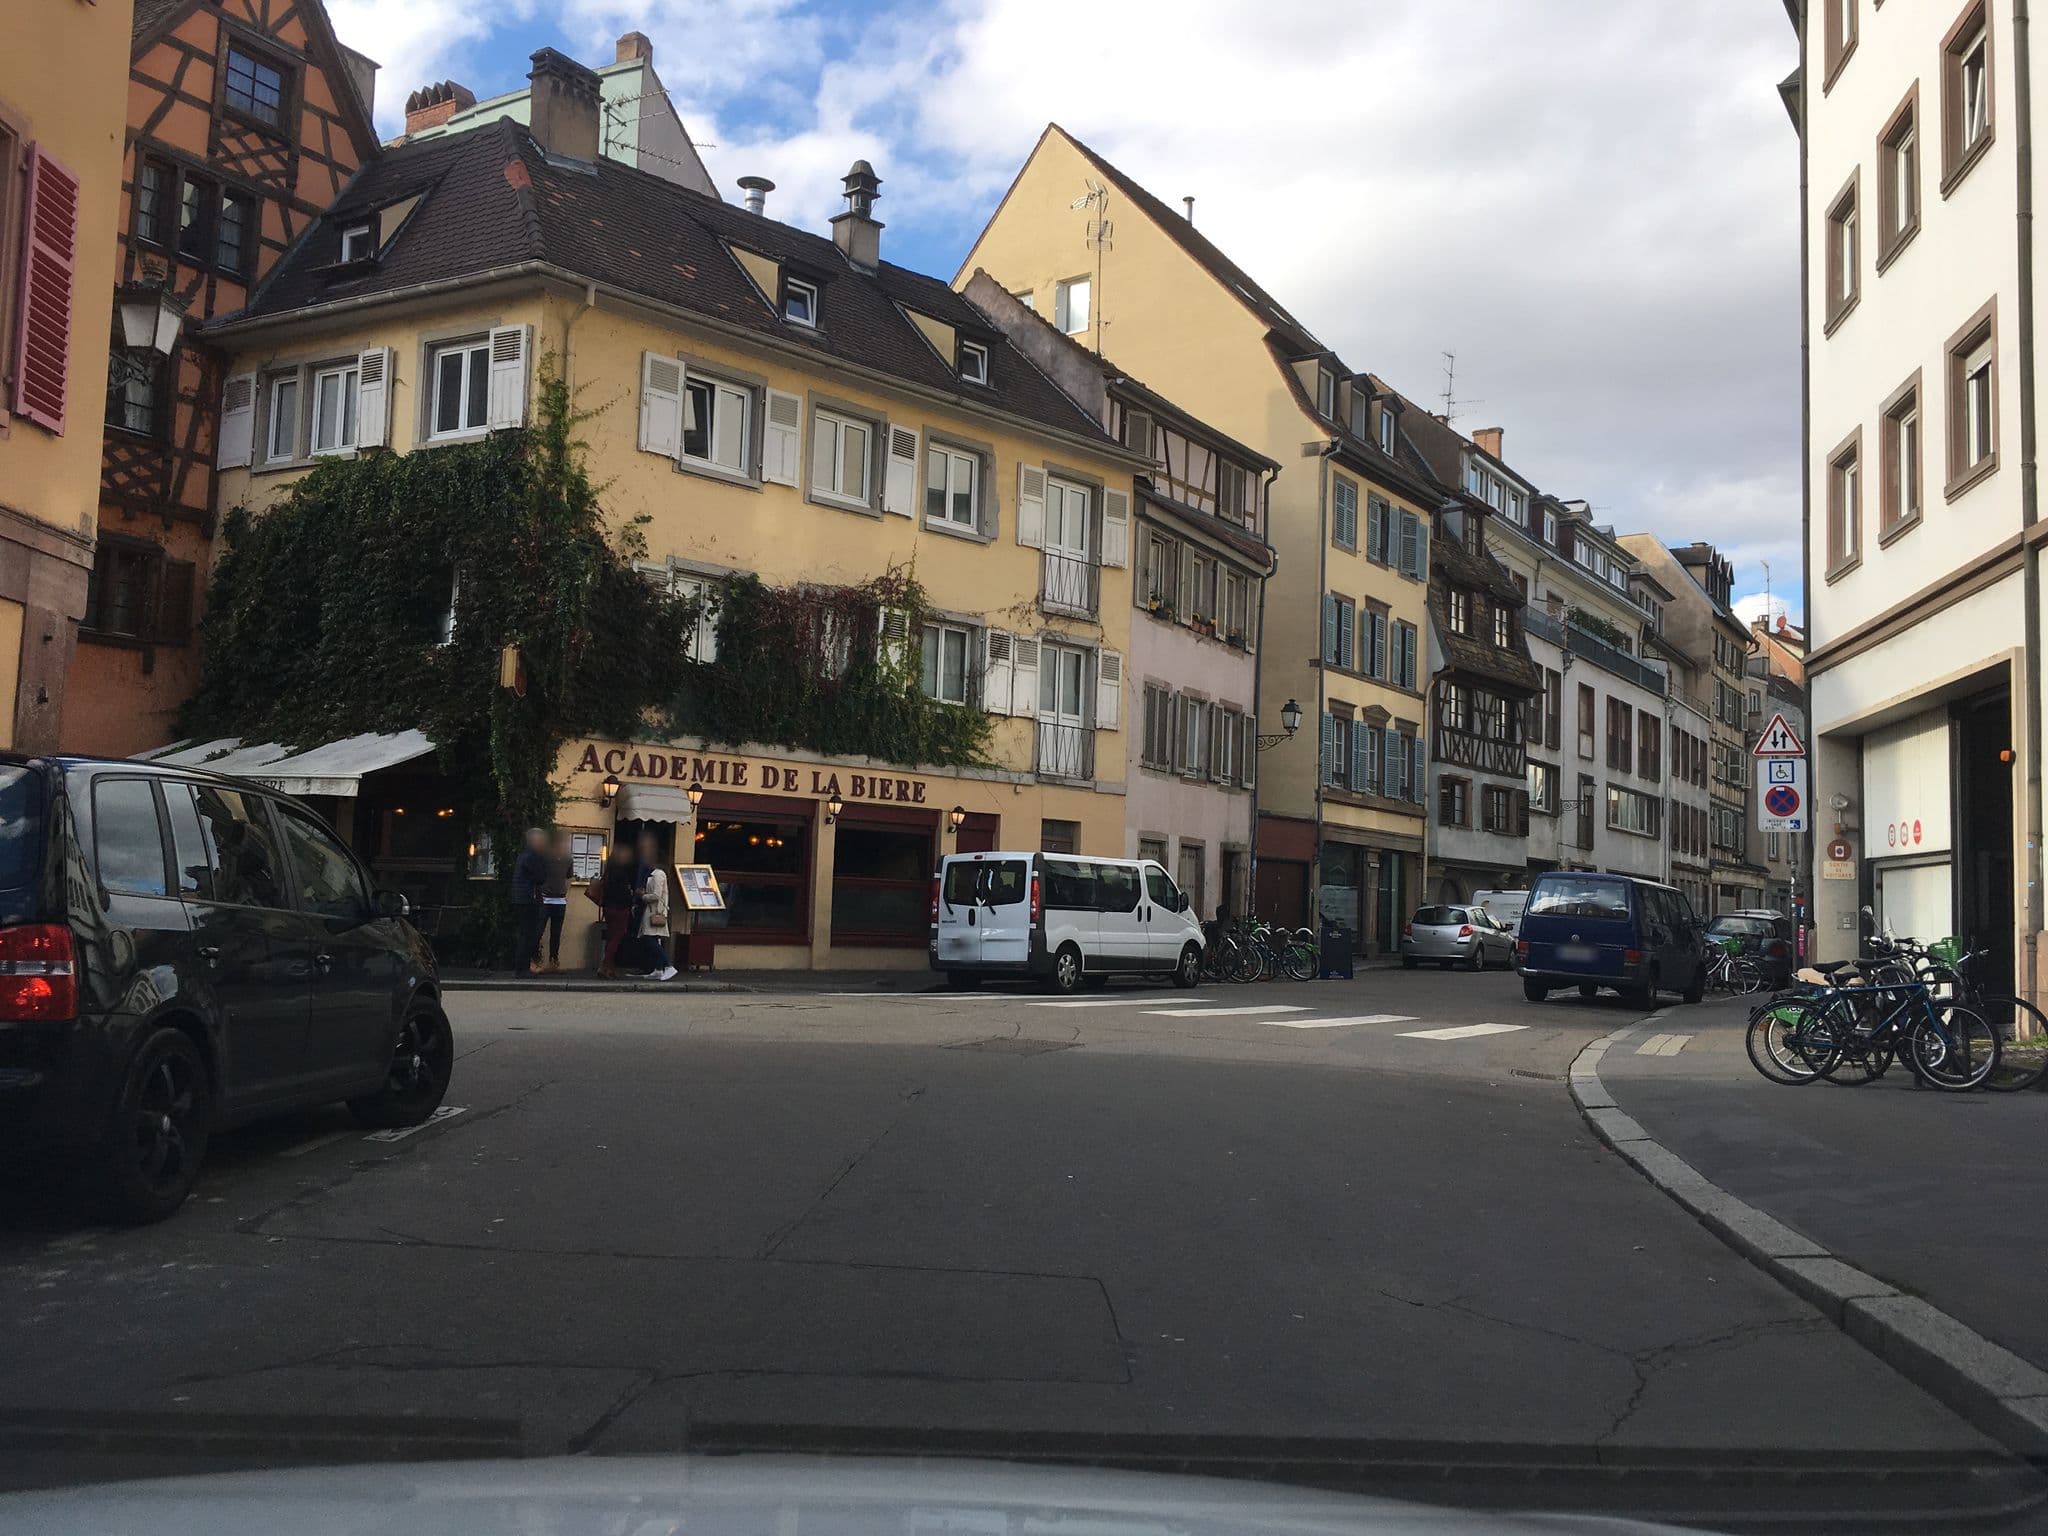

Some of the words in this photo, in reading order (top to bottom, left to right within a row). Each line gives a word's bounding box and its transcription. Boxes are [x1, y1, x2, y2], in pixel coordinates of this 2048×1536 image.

[577, 743, 748, 787] ACADEMIE
[761, 765, 799, 792] DE
[811, 771, 842, 796] LA
[851, 774, 926, 804] BIERE
